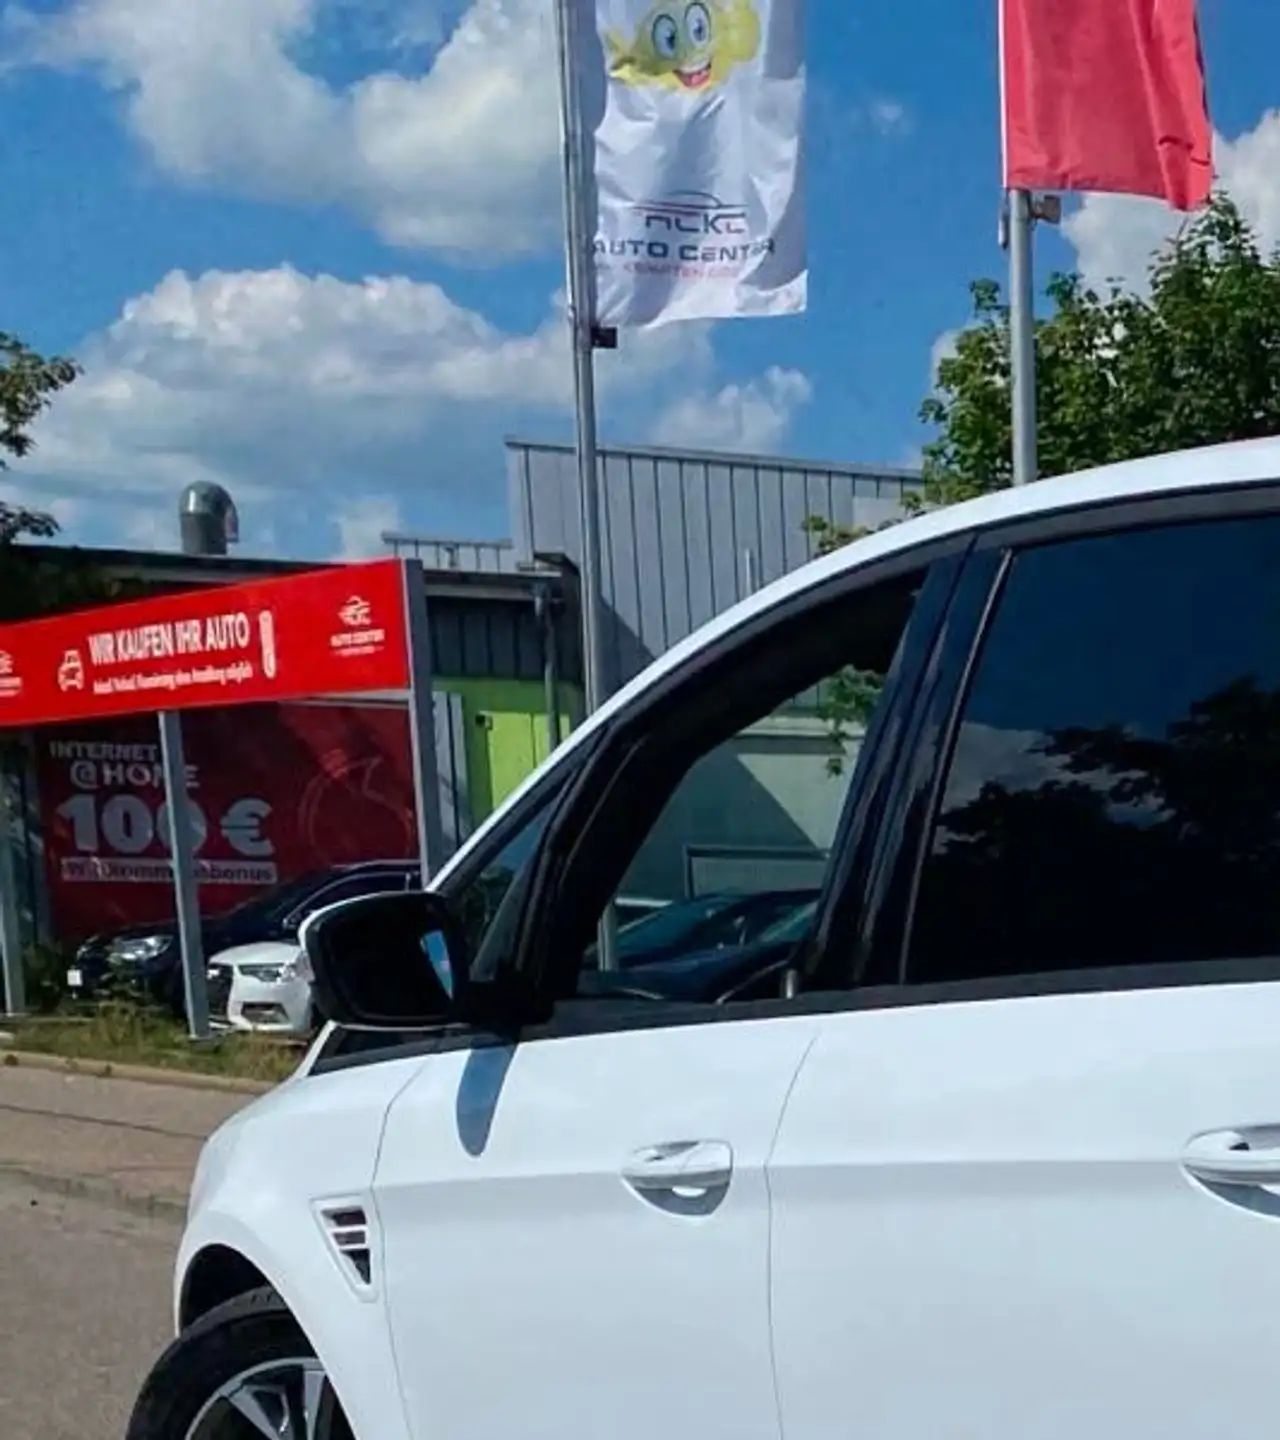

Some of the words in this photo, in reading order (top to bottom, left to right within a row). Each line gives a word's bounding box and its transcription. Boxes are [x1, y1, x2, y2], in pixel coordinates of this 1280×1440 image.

[592, 239, 670, 259] AUTO
[115, 622, 174, 663] KAUFEN
[175, 619, 203, 655] IHR
[205, 611, 250, 651] AUTO
[49, 741, 158, 761] INTERNET
[55, 792, 208, 855] 100
[219, 796, 275, 857] €
